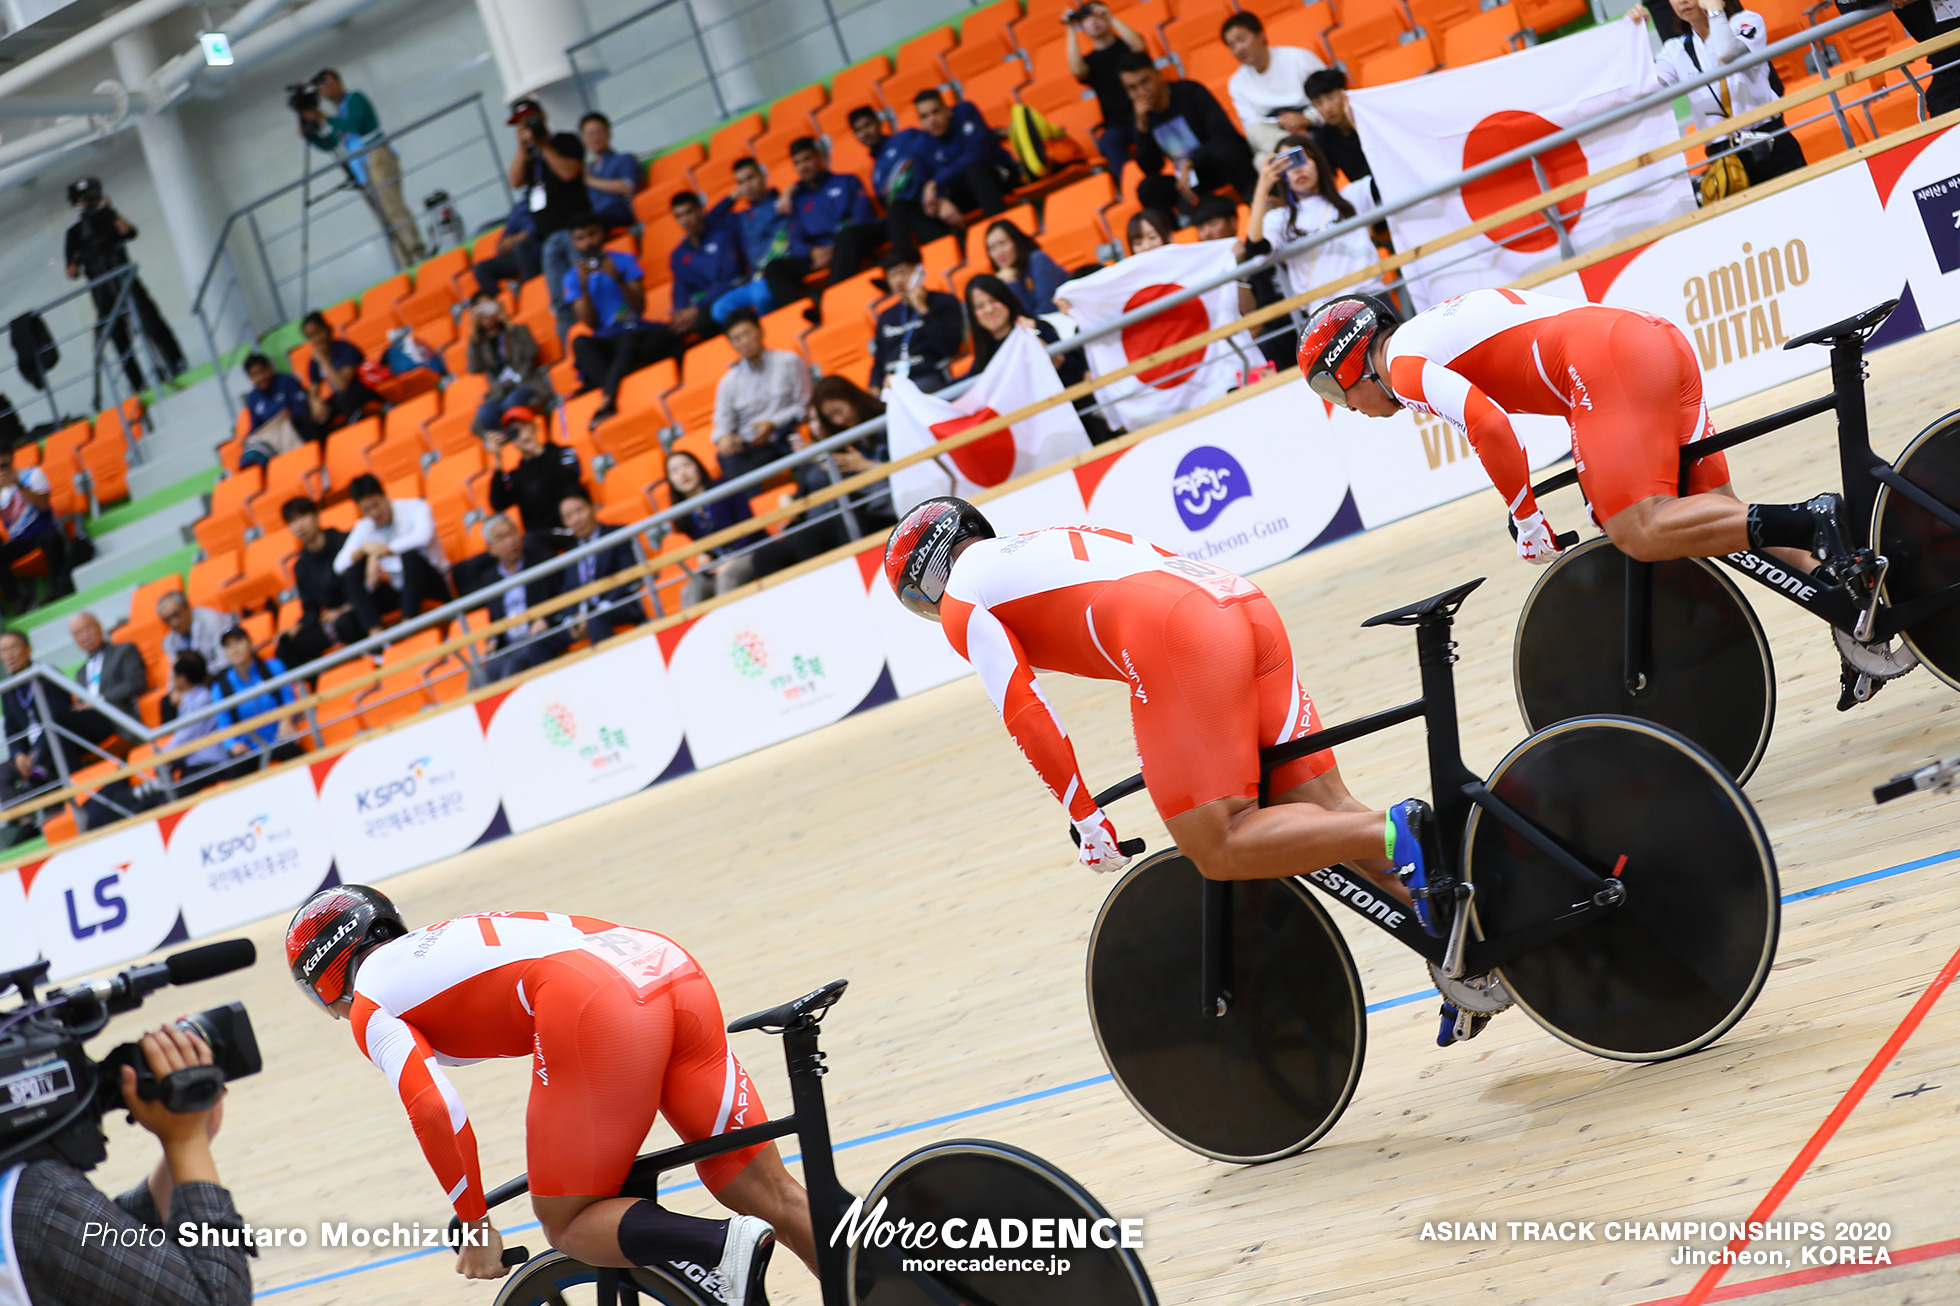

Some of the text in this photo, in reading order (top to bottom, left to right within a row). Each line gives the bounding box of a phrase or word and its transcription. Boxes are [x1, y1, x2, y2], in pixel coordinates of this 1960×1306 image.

[1683, 238, 1810, 326] amino
[1694, 298, 1790, 372] VITAL
[1175, 516, 1290, 562] incheon-Gun
[356, 774, 417, 814] KSPO
[199, 831, 257, 867] KSPO
[64, 873, 128, 940] LS
[8, 1072, 55, 1105] SPOTV
